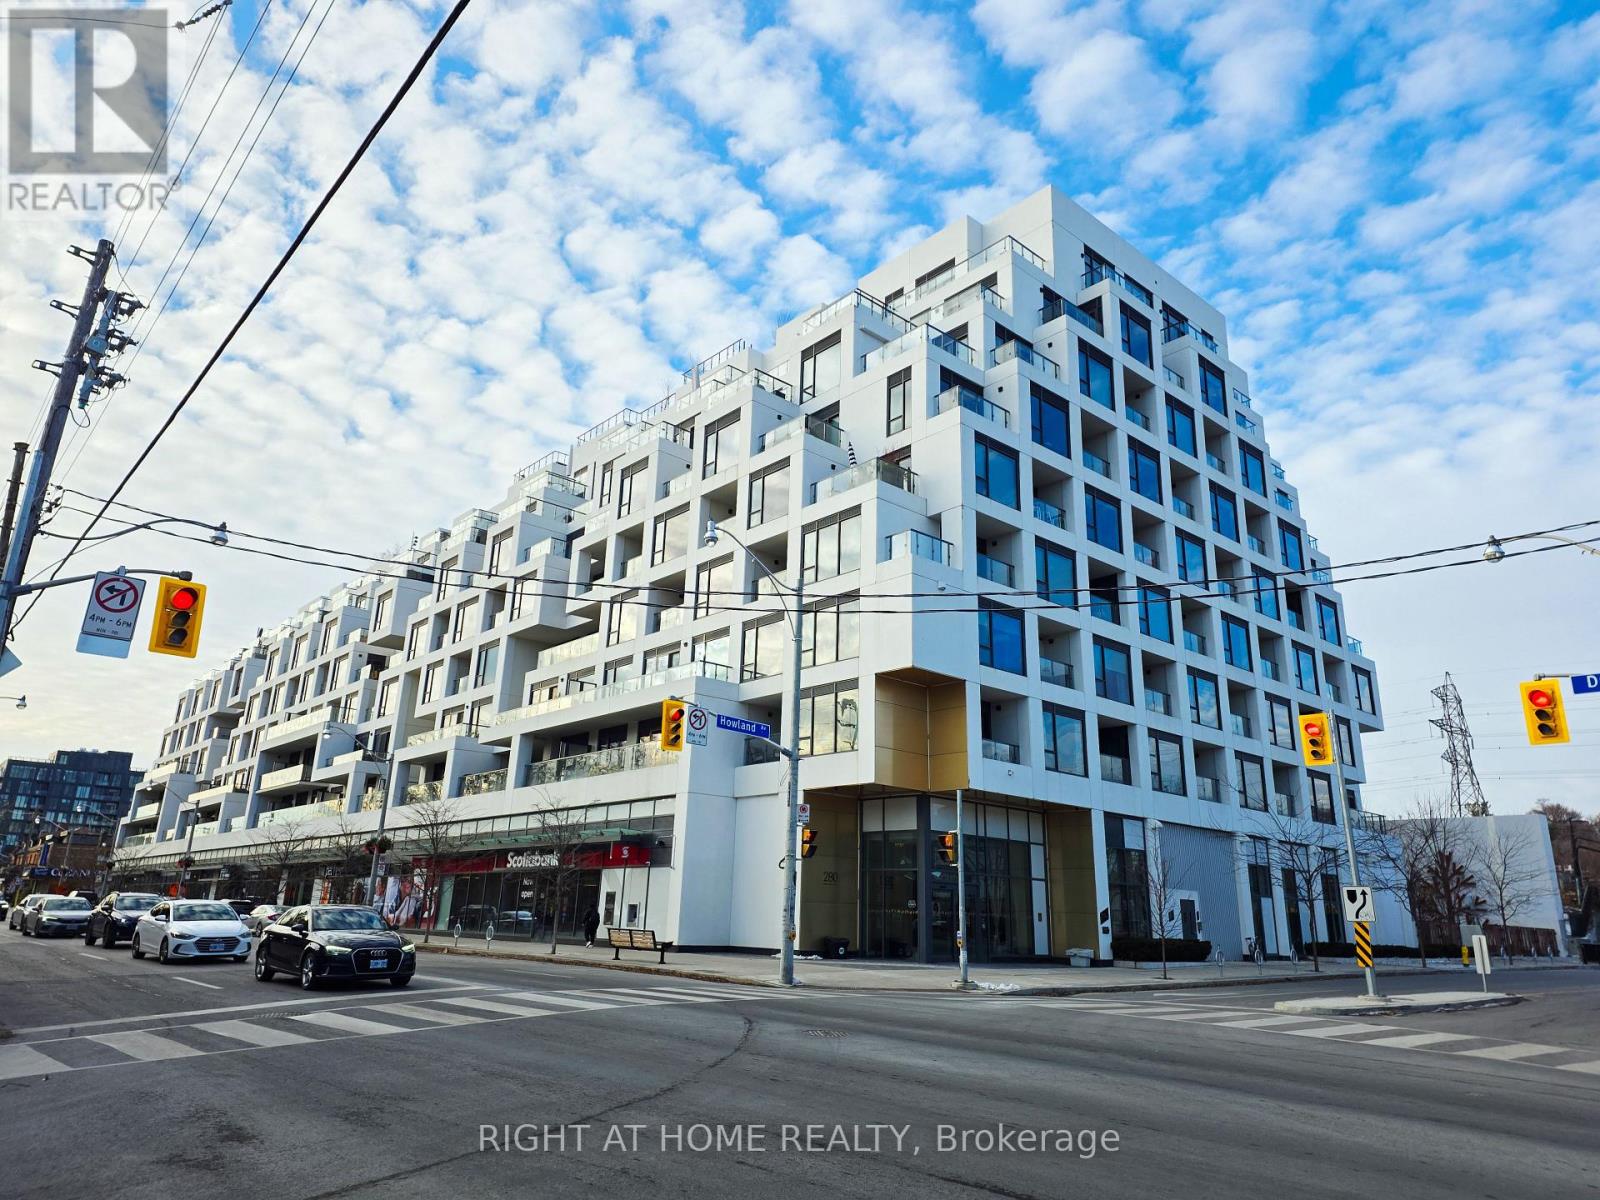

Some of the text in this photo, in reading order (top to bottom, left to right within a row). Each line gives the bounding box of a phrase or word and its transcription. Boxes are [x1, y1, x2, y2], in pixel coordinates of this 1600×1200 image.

[89, 614, 105, 624] 4PM
[116, 619, 132, 628] 6PM
[1586, 675, 1600, 688] D
[720, 715, 755, 732] Howland
[506, 849, 560, 868] Scotiabank
[521, 891, 533, 899] open
